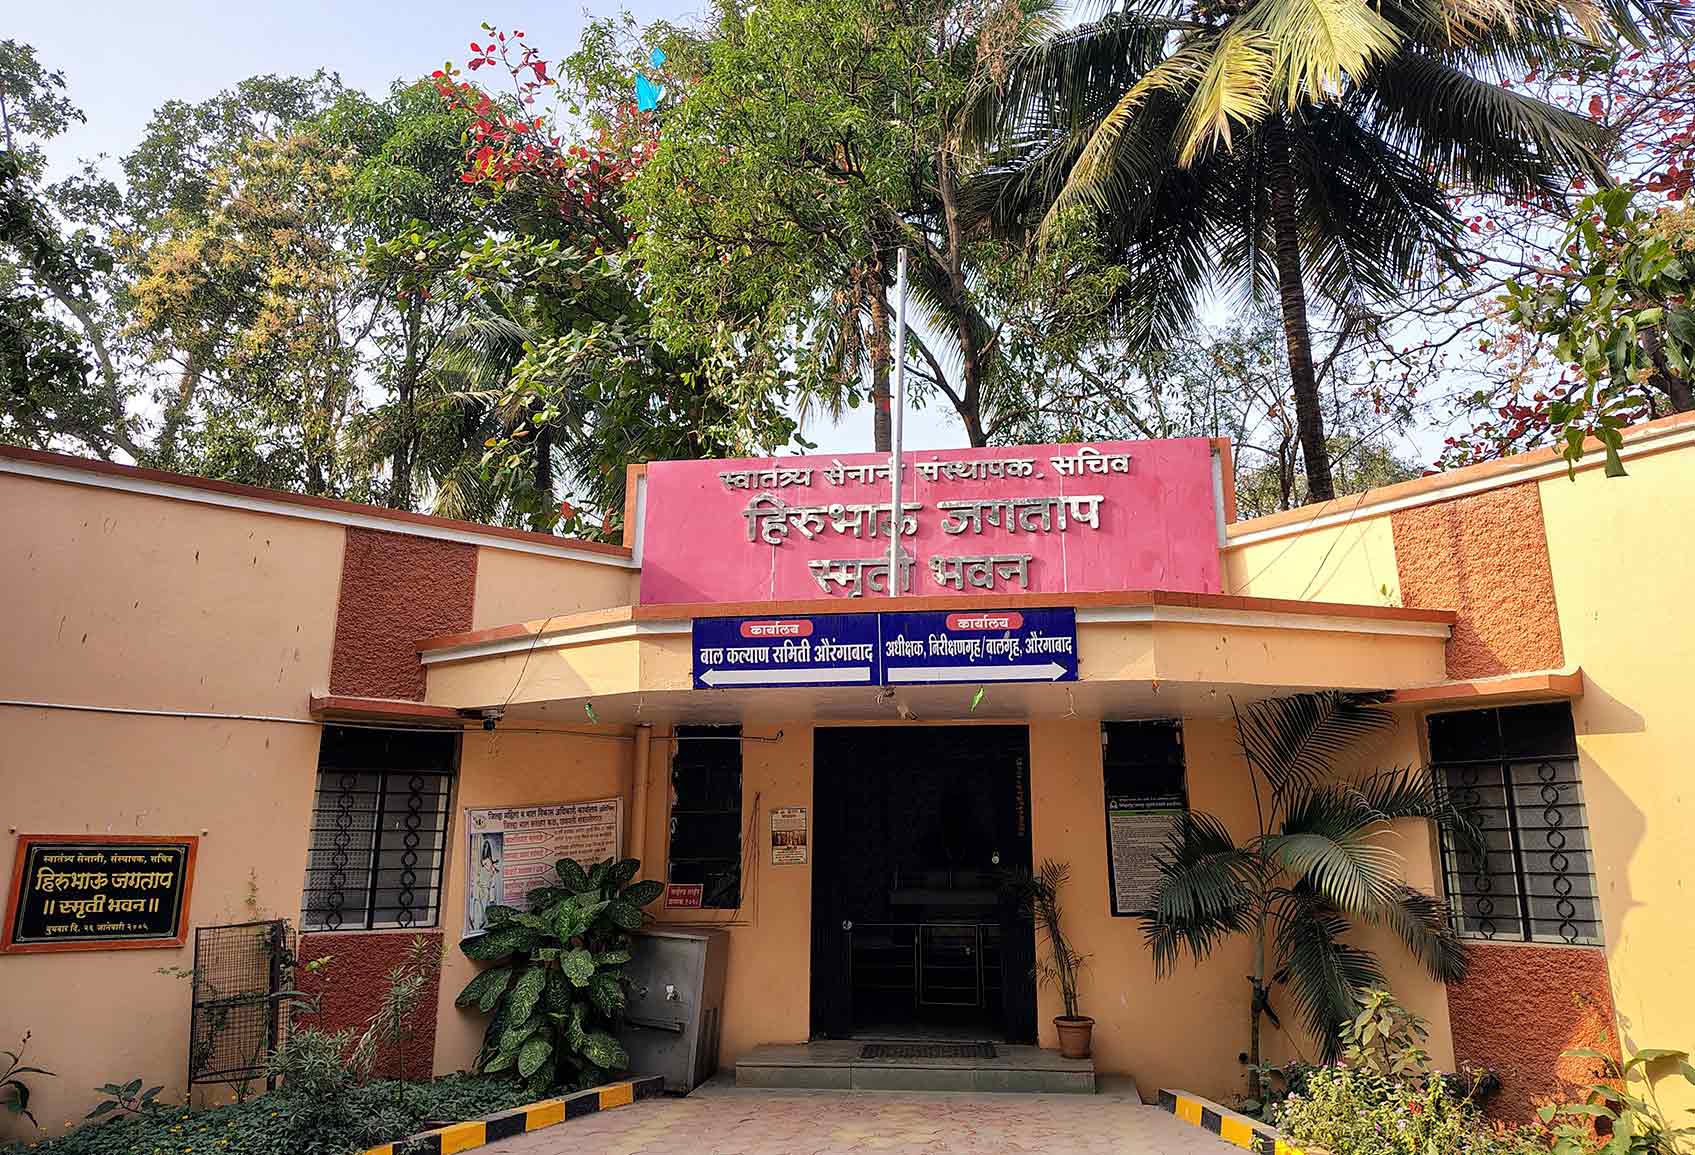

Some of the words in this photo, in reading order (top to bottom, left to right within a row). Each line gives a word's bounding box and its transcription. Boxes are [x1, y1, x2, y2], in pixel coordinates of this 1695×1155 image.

[1050, 447, 1131, 475] सचिव
[743, 493, 923, 544] हिरुभाऊ
[937, 494, 1105, 534] जगताप
[928, 553, 1032, 590] भवन
[750, 621, 800, 635] कार्यालय
[957, 615, 1009, 630] कार्यालय
[700, 648, 724, 664] बाल
[726, 646, 769, 664] कल्याण
[772, 639, 811, 663] समिती
[814, 637, 873, 662] औरंगाबाद
[1025, 631, 1072, 654] औरंगाबाद
[35, 867, 108, 892] हिरुभाऊ
[112, 872, 174, 890] जगताप
[59, 894, 106, 918] स्मृती
[108, 898, 147, 912] भवन
